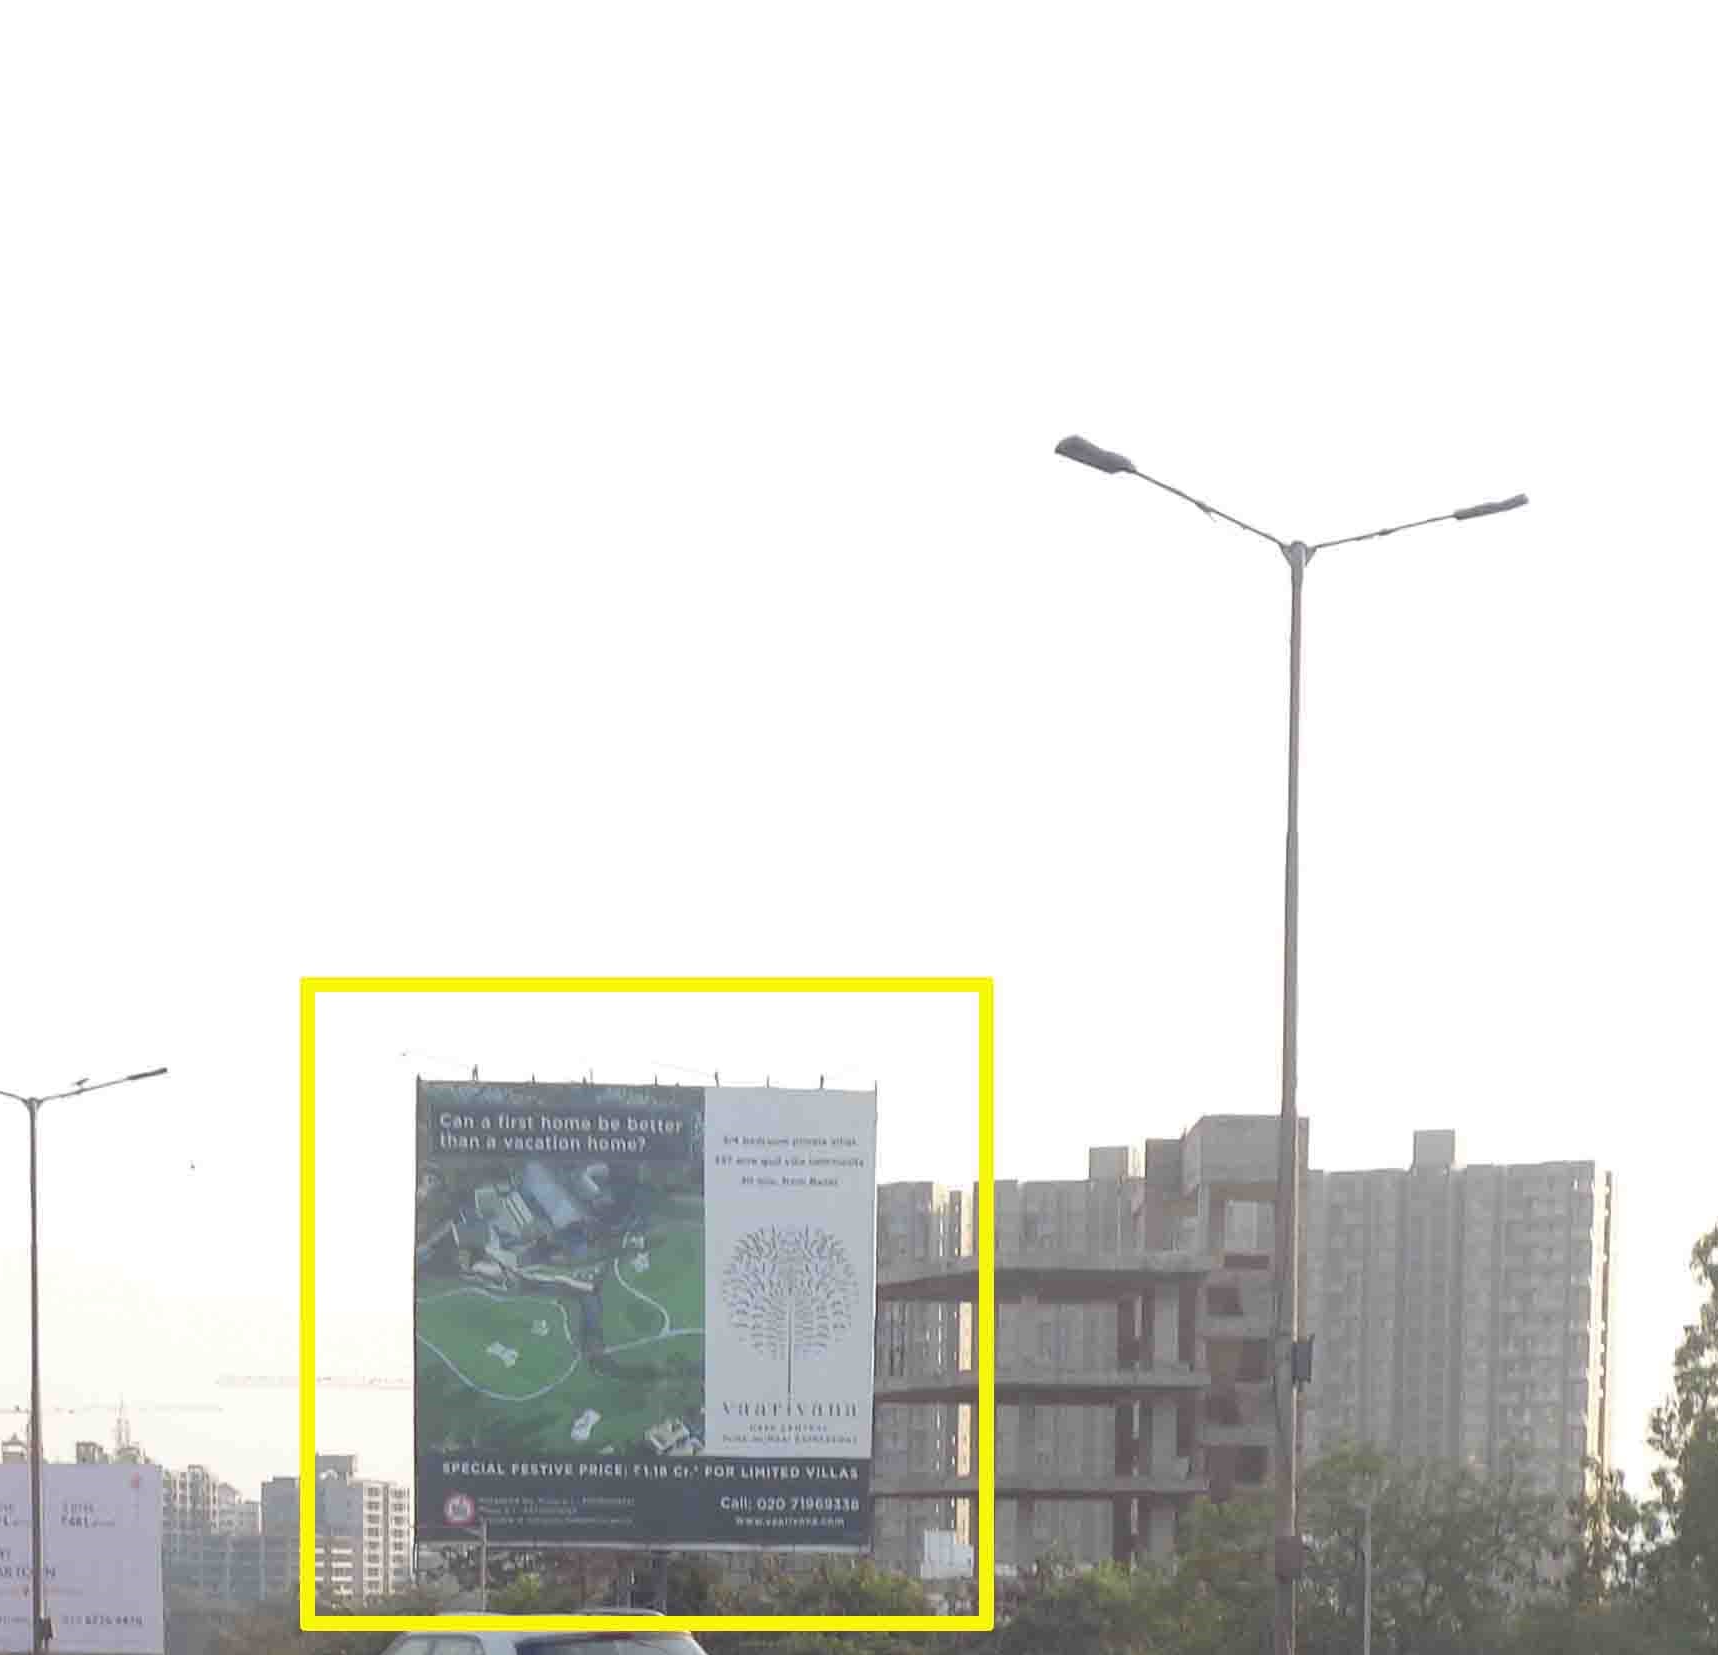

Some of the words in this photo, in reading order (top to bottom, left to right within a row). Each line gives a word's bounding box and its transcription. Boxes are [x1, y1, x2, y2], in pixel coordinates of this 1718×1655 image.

[439, 1112, 474, 1129] Can
[482, 1116, 491, 1129] a
[498, 1111, 533, 1130] first
[540, 1112, 591, 1132] home
[598, 1114, 620, 1132] be
[627, 1114, 683, 1135] better
[440, 1131, 481, 1149] than
[486, 1135, 496, 1149] a
[504, 1135, 580, 1151] vacation
[587, 1135, 646, 1152] home?
[442, 1462, 505, 1475] SPECIAL
[511, 1463, 573, 1476] FESTIVE
[705, 1465, 734, 1479] FOR
[741, 1466, 800, 1479] LIMITED
[806, 1467, 859, 1481] VILLAS
